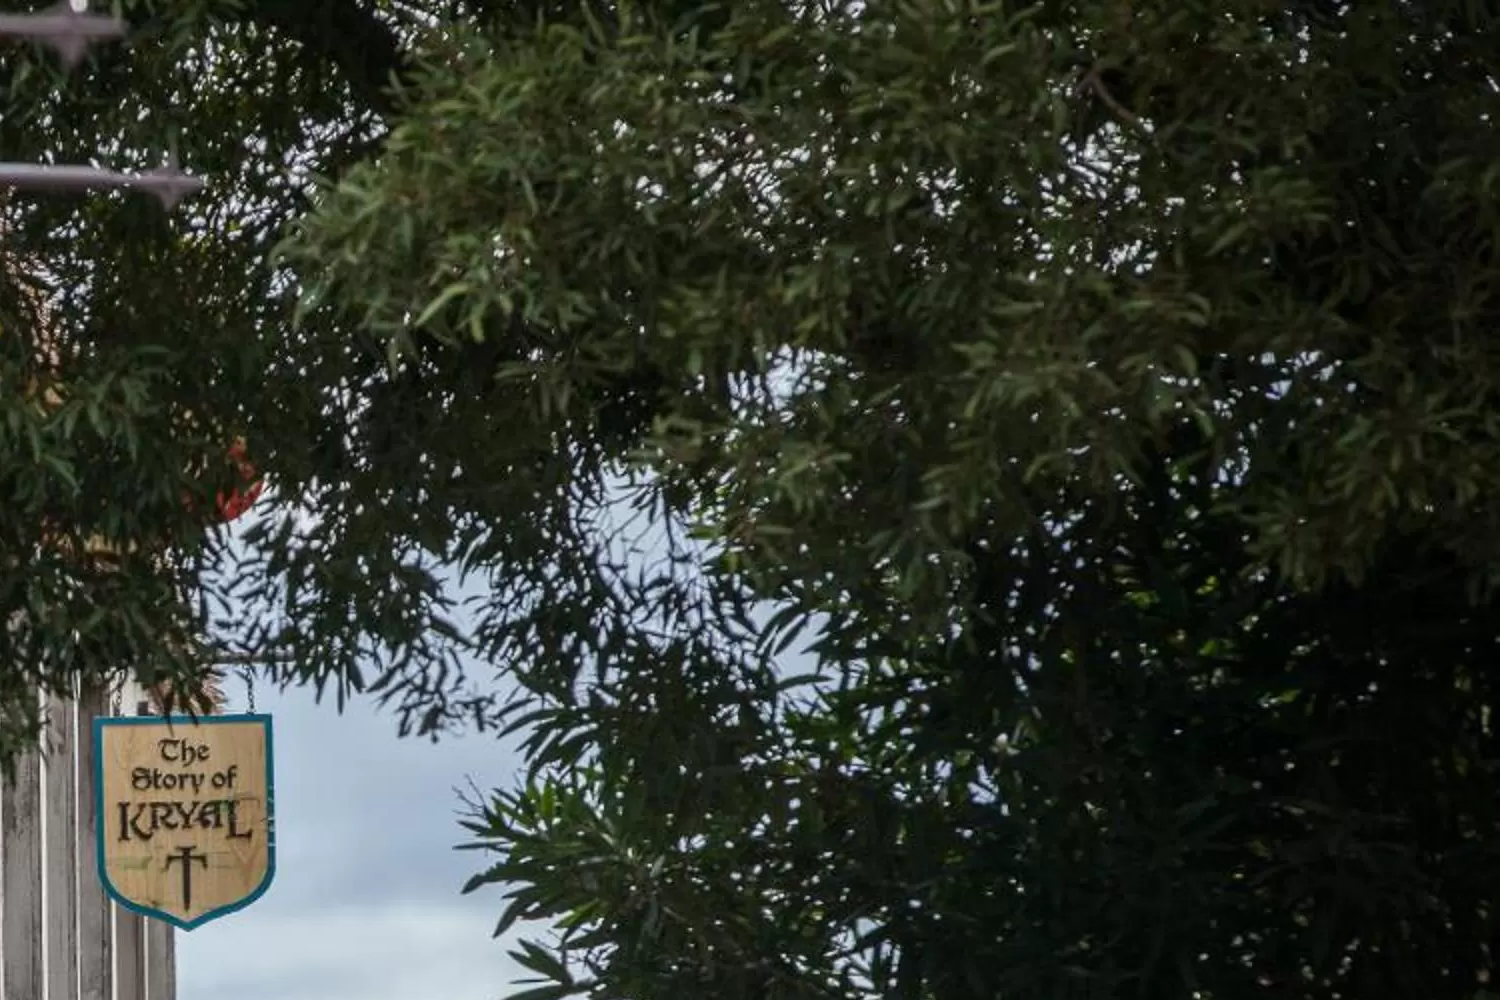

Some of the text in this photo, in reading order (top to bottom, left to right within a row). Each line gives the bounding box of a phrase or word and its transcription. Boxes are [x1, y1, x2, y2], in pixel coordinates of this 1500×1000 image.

[157, 736, 211, 767] The
[131, 764, 238, 794] Story of
[117, 799, 255, 843] KRYAL
